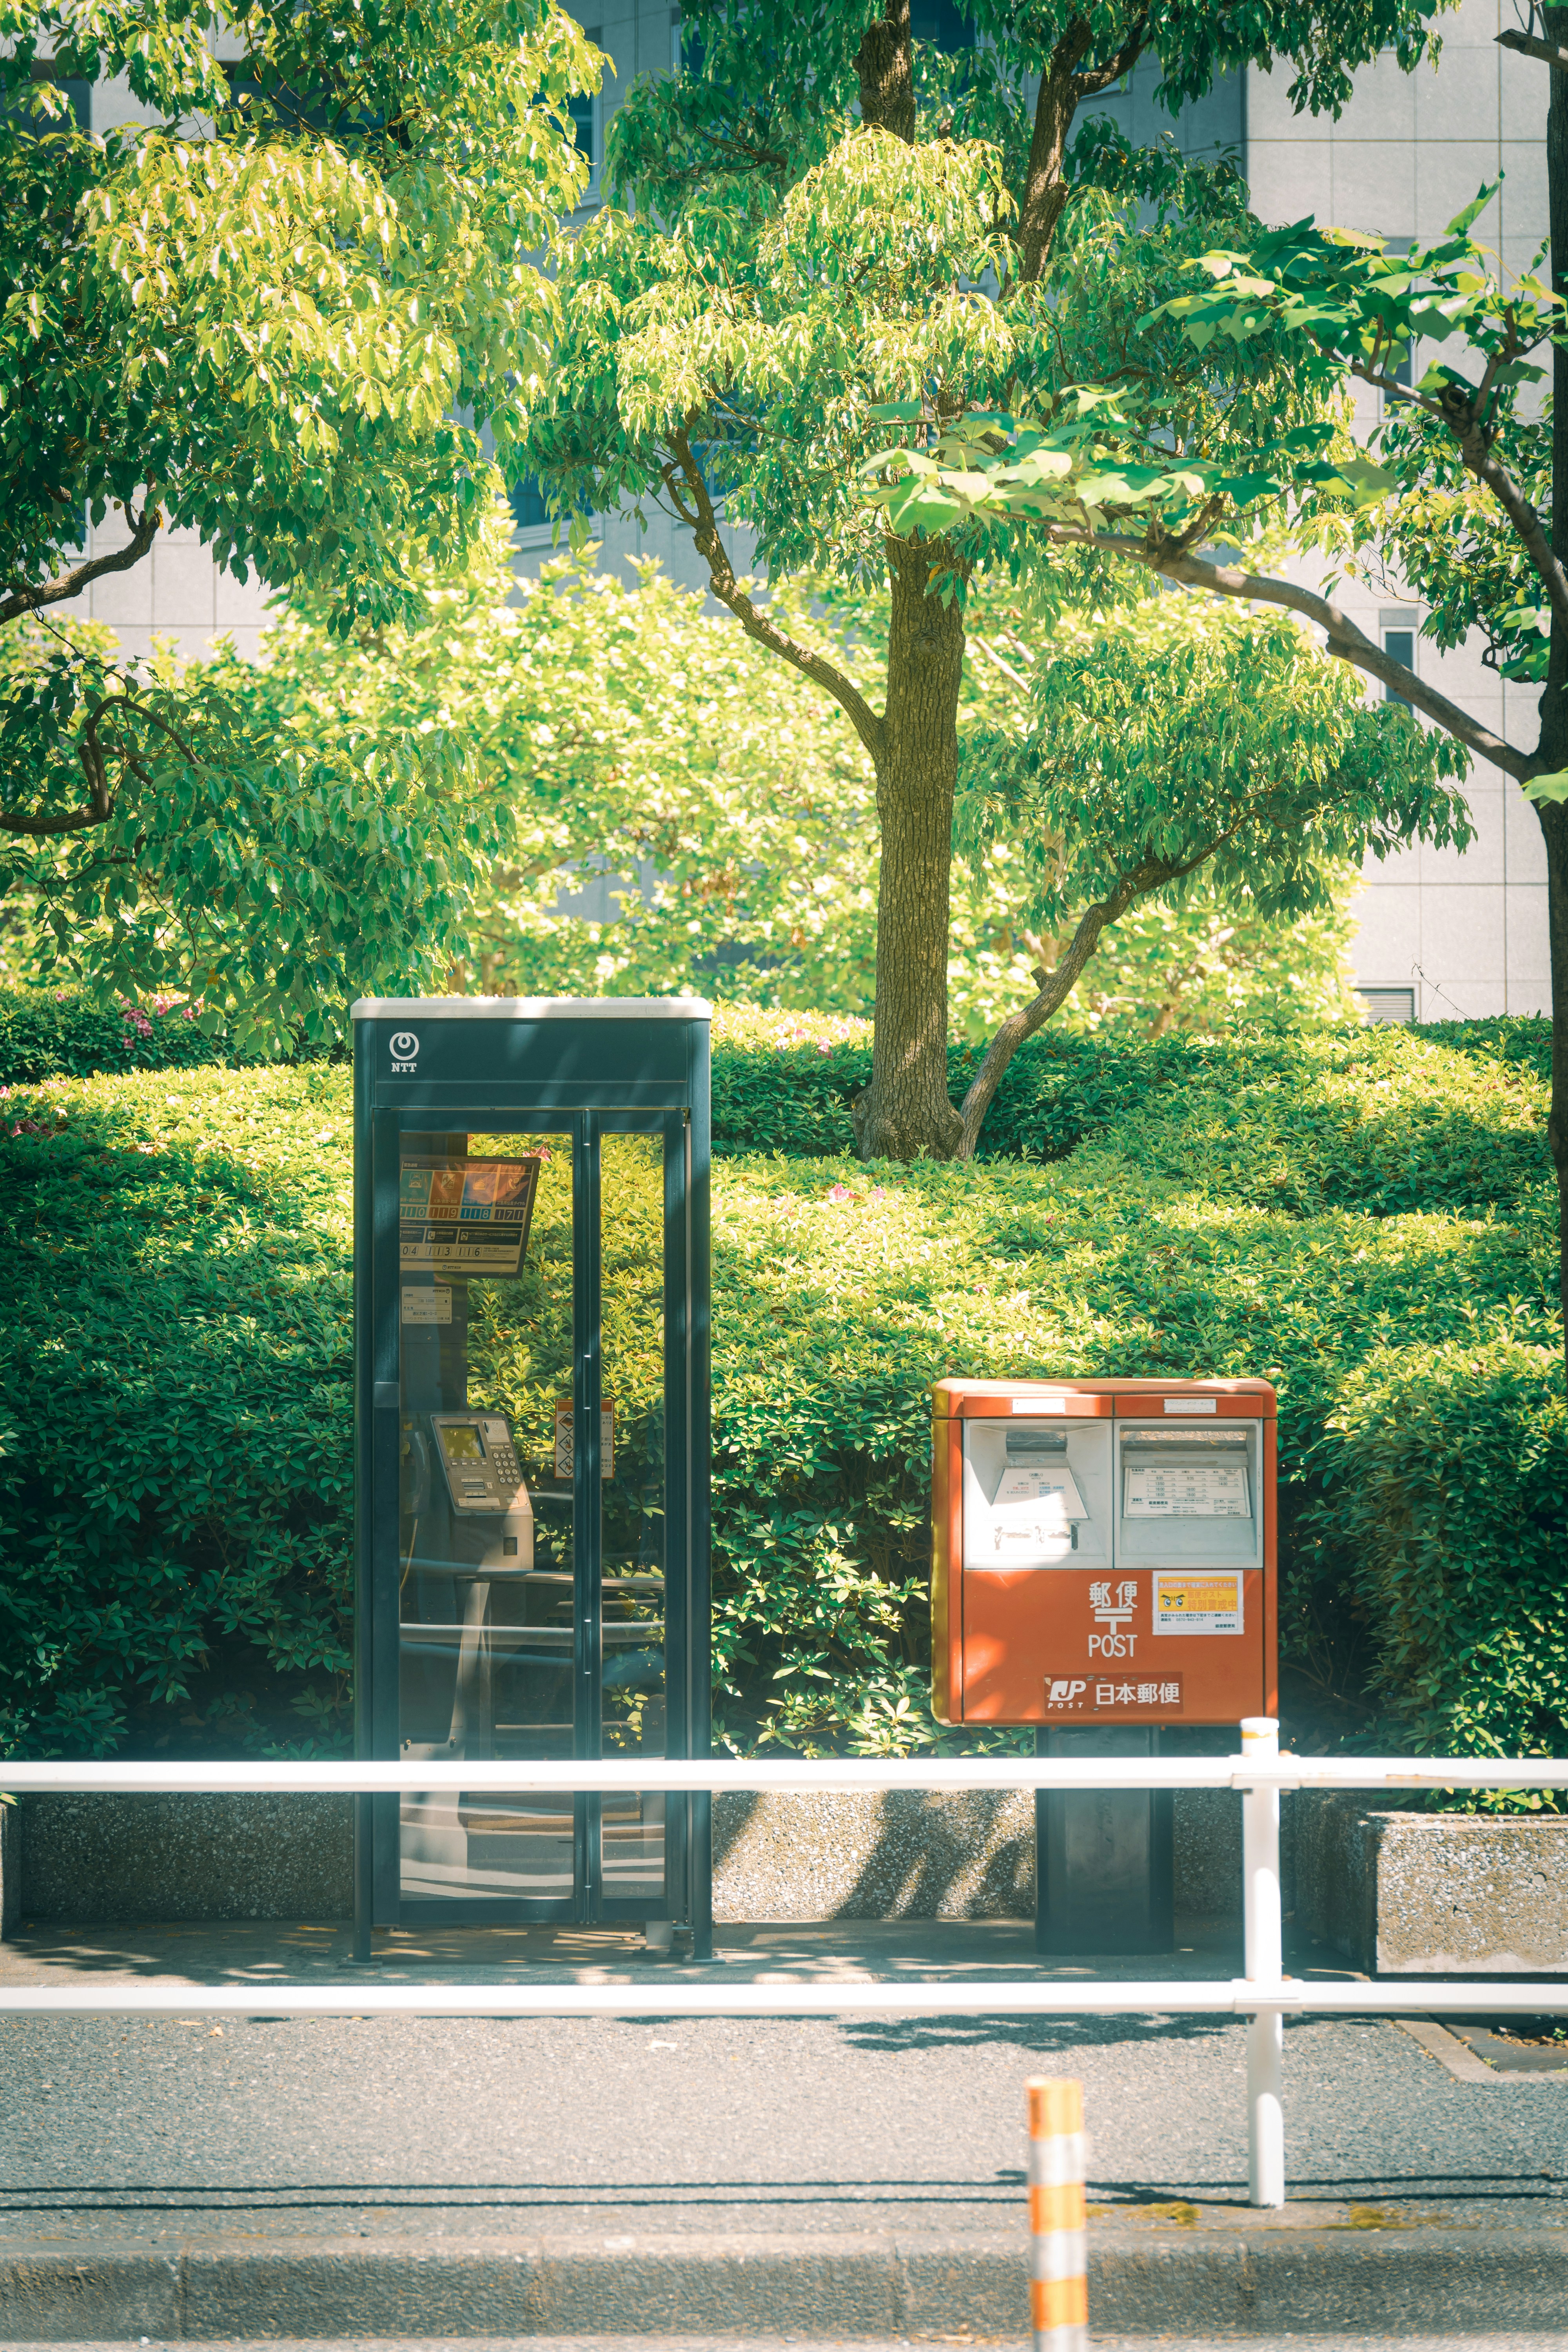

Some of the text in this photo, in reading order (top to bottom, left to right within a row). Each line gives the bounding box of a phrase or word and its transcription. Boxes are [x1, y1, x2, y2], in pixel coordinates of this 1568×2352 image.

[391, 1063, 417, 1072] NTT
[400, 1207, 425, 1216] 110
[432, 1208, 457, 1218] 119
[464, 1209, 489, 1218] 118
[498, 1210, 521, 1219] 171
[429, 1247, 450, 1256] 113
[459, 1248, 480, 1256] 116
[1089, 1581, 1138, 1608] 郵便
[1188, 1599, 1237, 1610] 特別警戒中
[1088, 1634, 1138, 1657] POST
[1049, 1681, 1087, 1701] JP
[1096, 1683, 1180, 1705] 日本郵便
